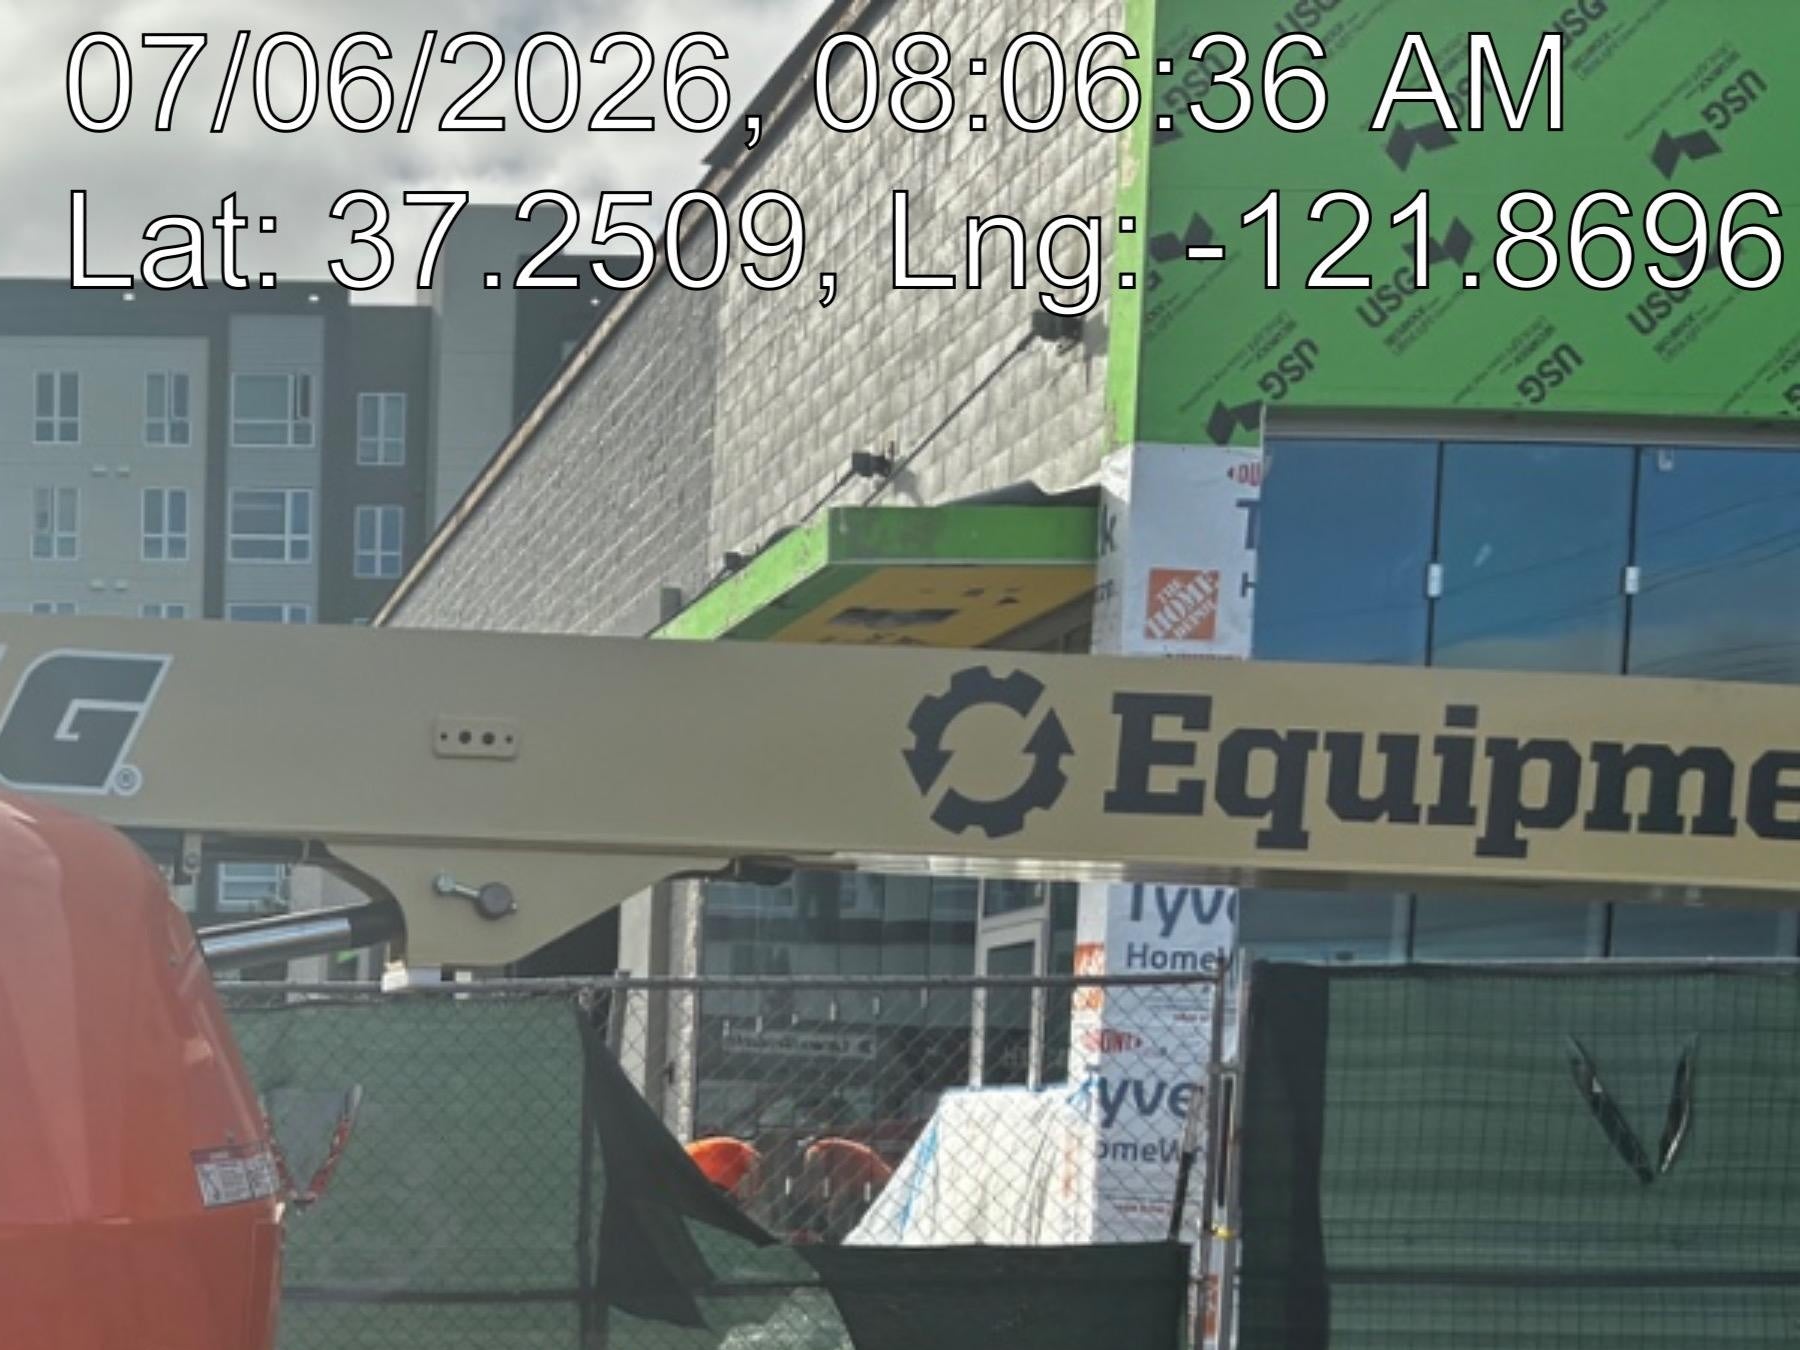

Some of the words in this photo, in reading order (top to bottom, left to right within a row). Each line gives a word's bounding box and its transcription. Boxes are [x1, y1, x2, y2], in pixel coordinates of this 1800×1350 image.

[1700, 68, 1767, 130] USG
[1257, 338, 1320, 400] USG
[1517, 343, 1584, 404] USG
